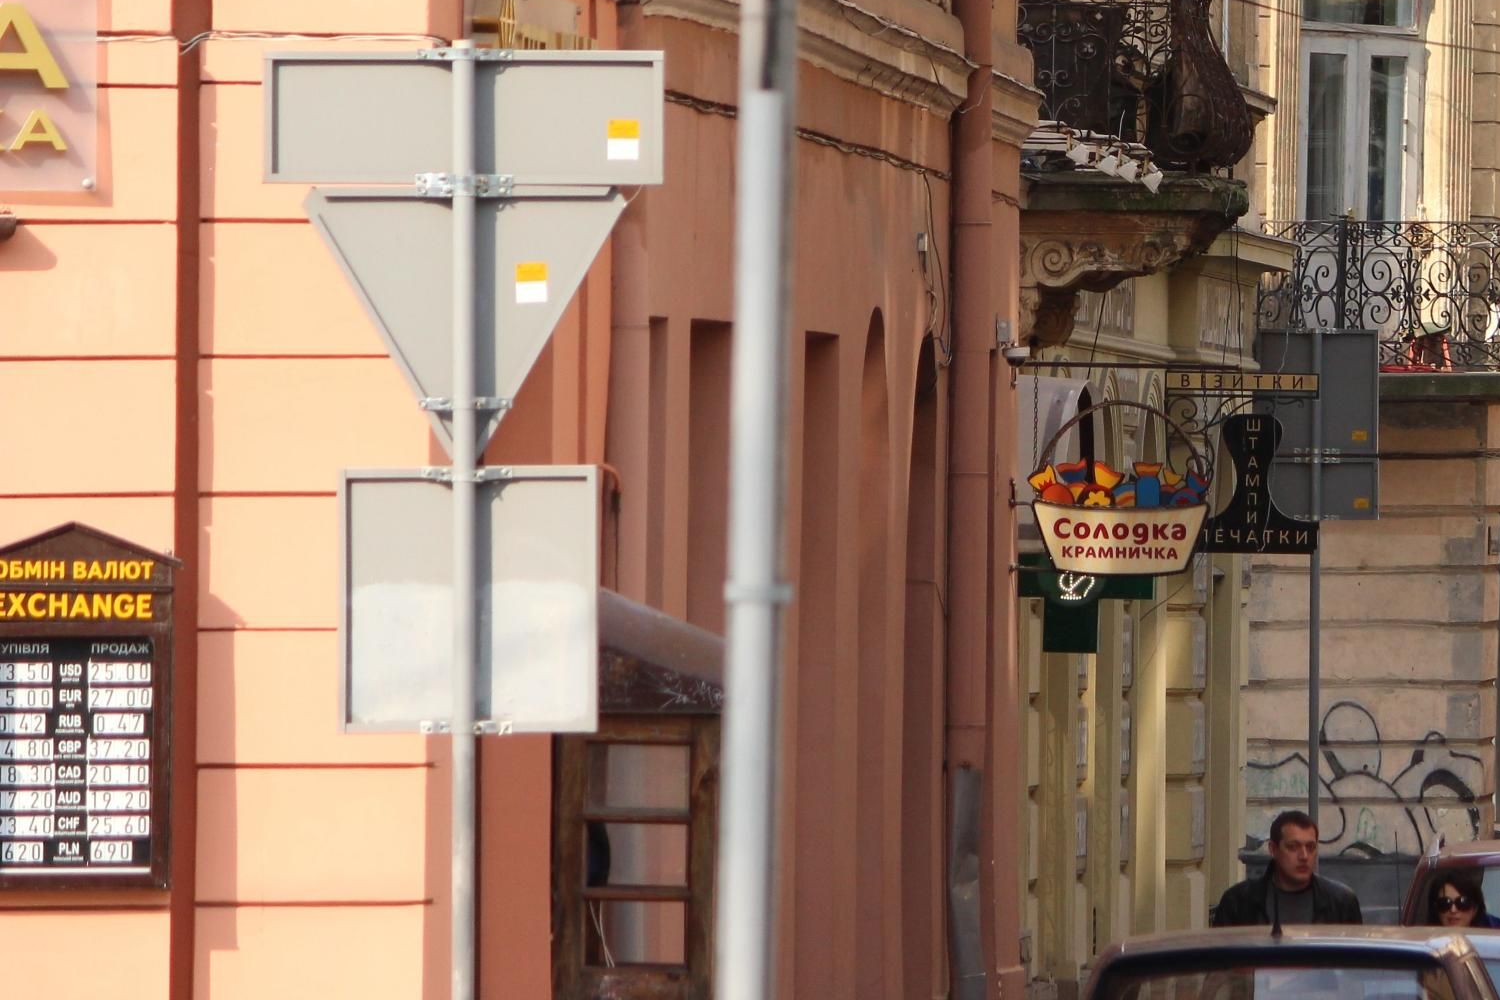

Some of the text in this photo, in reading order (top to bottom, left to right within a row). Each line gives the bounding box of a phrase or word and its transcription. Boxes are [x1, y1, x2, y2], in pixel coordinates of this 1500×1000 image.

[1180, 375, 1305, 390] ВІЗИТКИ
[1245, 418, 1262, 524] ШТАМПИ
[1053, 517, 1188, 546] Солодка
[1061, 544, 1179, 561] КРАМНИЧКА
[73, 560, 154, 580] ВАЛЮТ
[91, 643, 149, 655] ПРОДАЖ
[59, 663, 82, 677] USD
[91, 663, 151, 681] 25.00
[59, 689, 82, 702] EUR
[91, 689, 150, 707] 27.00
[58, 714, 82, 728] RUB
[96, 714, 141, 732] 0.47
[58, 741, 82, 754] GBP
[89, 740, 146, 758] 37.20
[57, 765, 81, 779] CAD
[89, 766, 146, 783] 20.10
[57, 791, 81, 804] AUD
[90, 792, 147, 809] 19.20
[57, 816, 80, 829] CHF
[90, 817, 147, 835] 25.60
[4, 843, 41, 860] 620
[58, 842, 80, 855] PLN
[93, 843, 129, 860] 690
